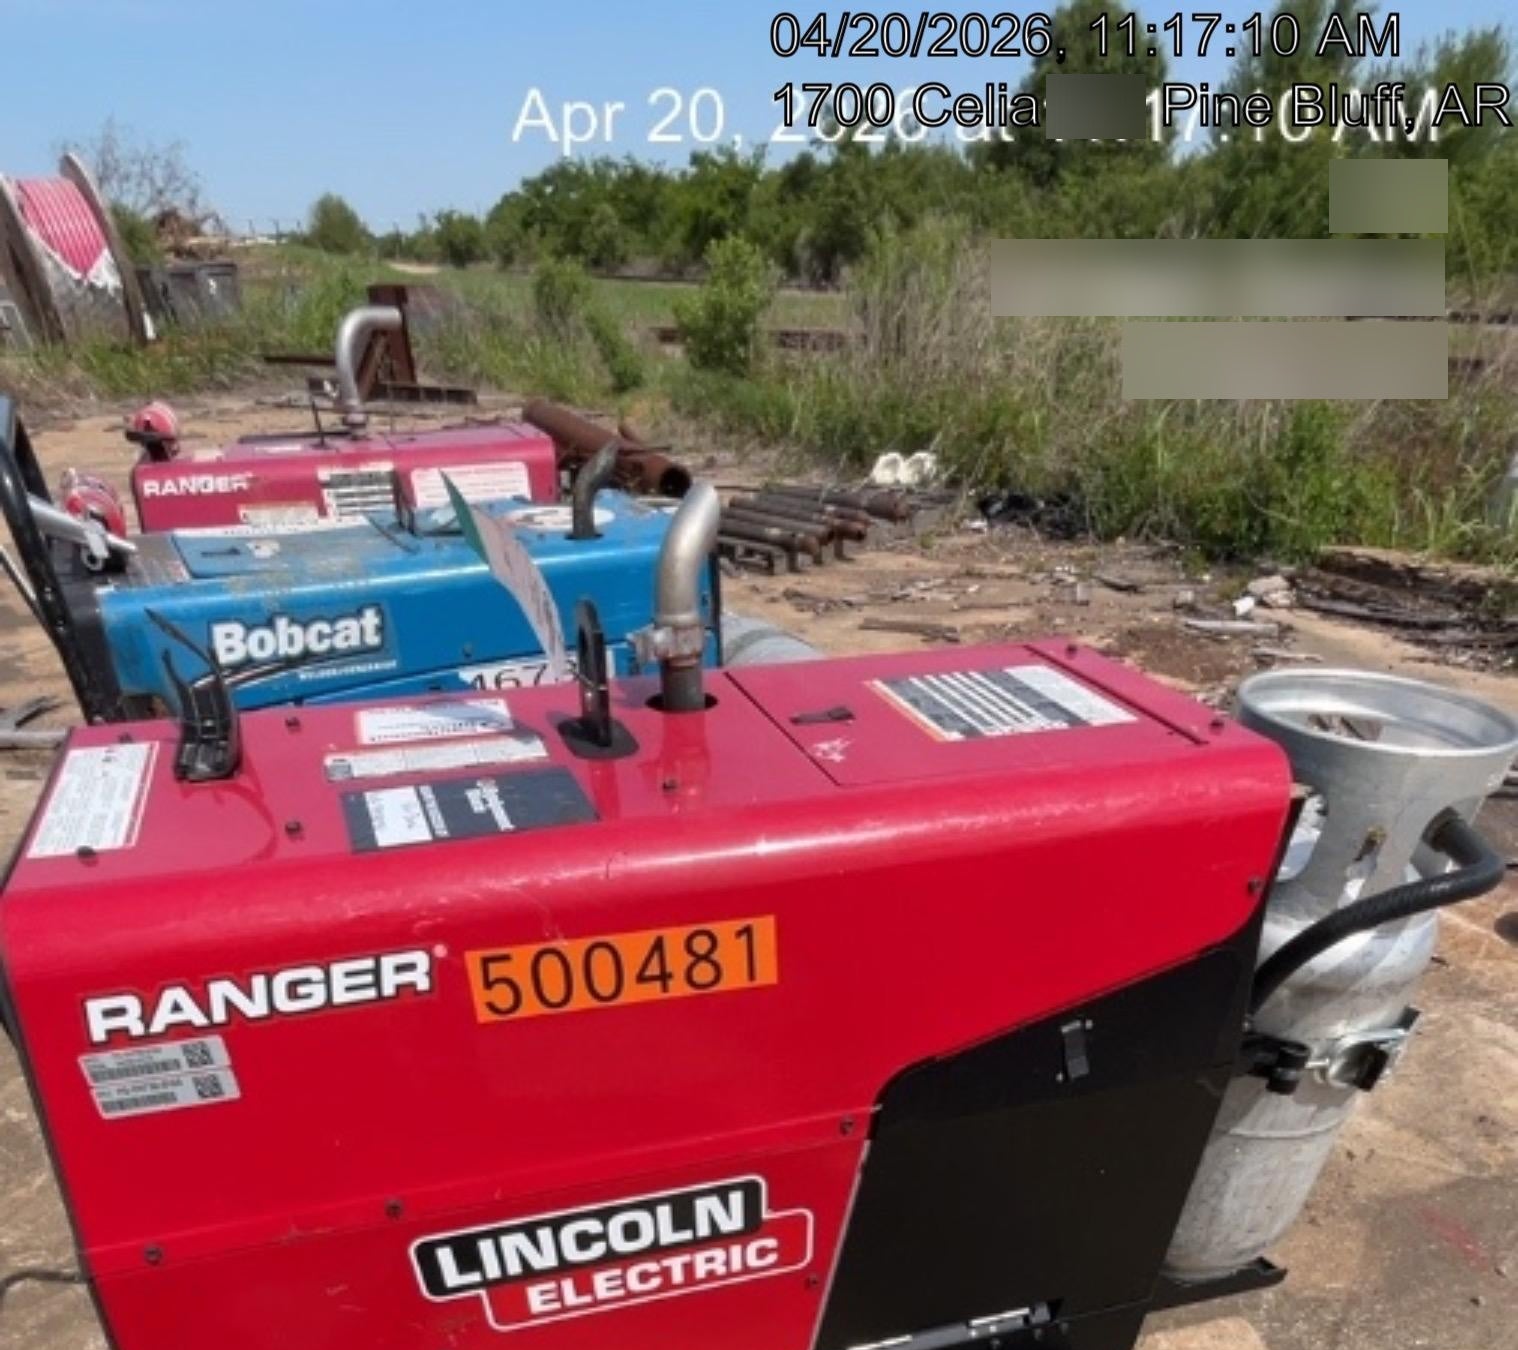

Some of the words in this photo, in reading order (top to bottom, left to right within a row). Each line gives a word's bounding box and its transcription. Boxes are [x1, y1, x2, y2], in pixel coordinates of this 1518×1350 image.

[142, 474, 250, 498] RANGER
[212, 605, 383, 665] Bobcat
[85, 949, 431, 1043] RANGER
[479, 923, 757, 1017] 500481
[435, 1189, 745, 1288] LINCOLN
[525, 1238, 779, 1315] ELECTRIC
